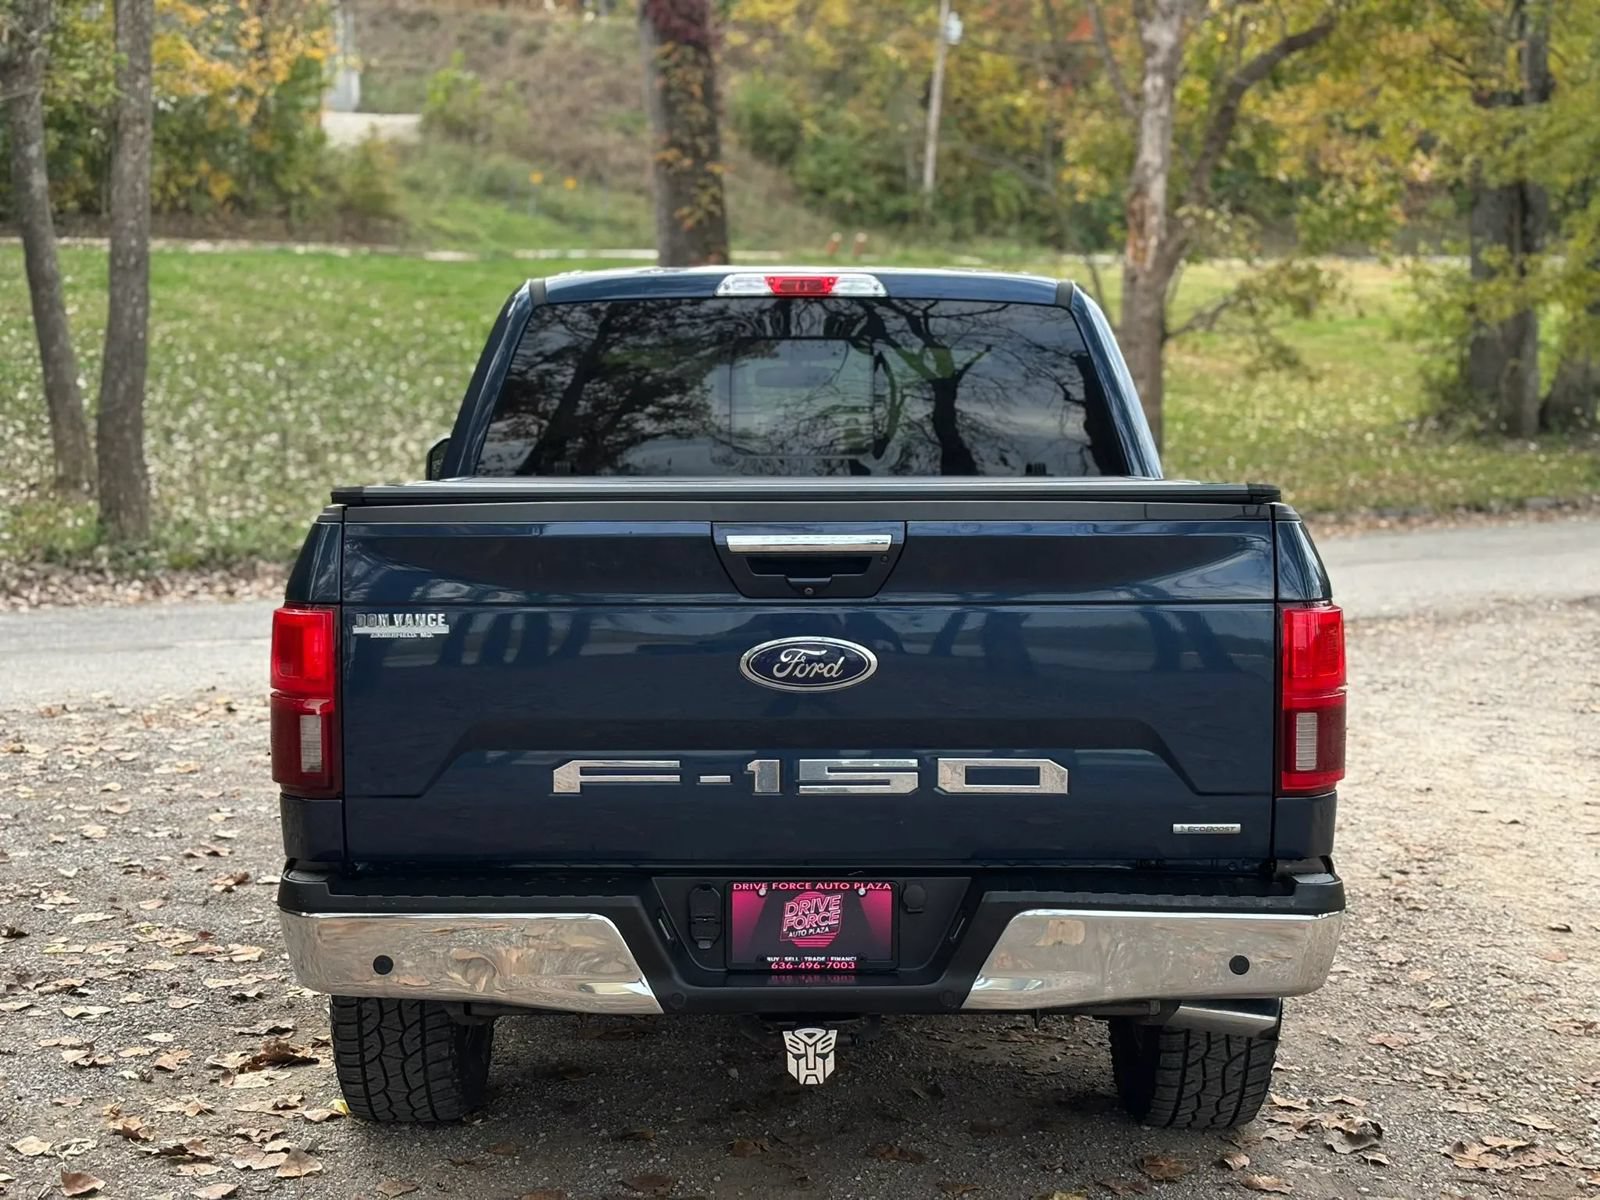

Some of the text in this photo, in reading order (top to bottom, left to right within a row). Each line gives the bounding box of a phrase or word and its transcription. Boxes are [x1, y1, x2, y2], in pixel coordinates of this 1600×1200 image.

[355, 613, 446, 628] DON VANCE
[772, 648, 845, 678] Ford
[551, 757, 1070, 795] F-150
[733, 882, 892, 890] DRIVE FORCE AUTO PLAZA
[784, 894, 841, 917] DRIVE
[783, 909, 841, 932] FORCE
[788, 926, 830, 938] AUTO PLAZA
[771, 961, 856, 970] 636-496-7003
